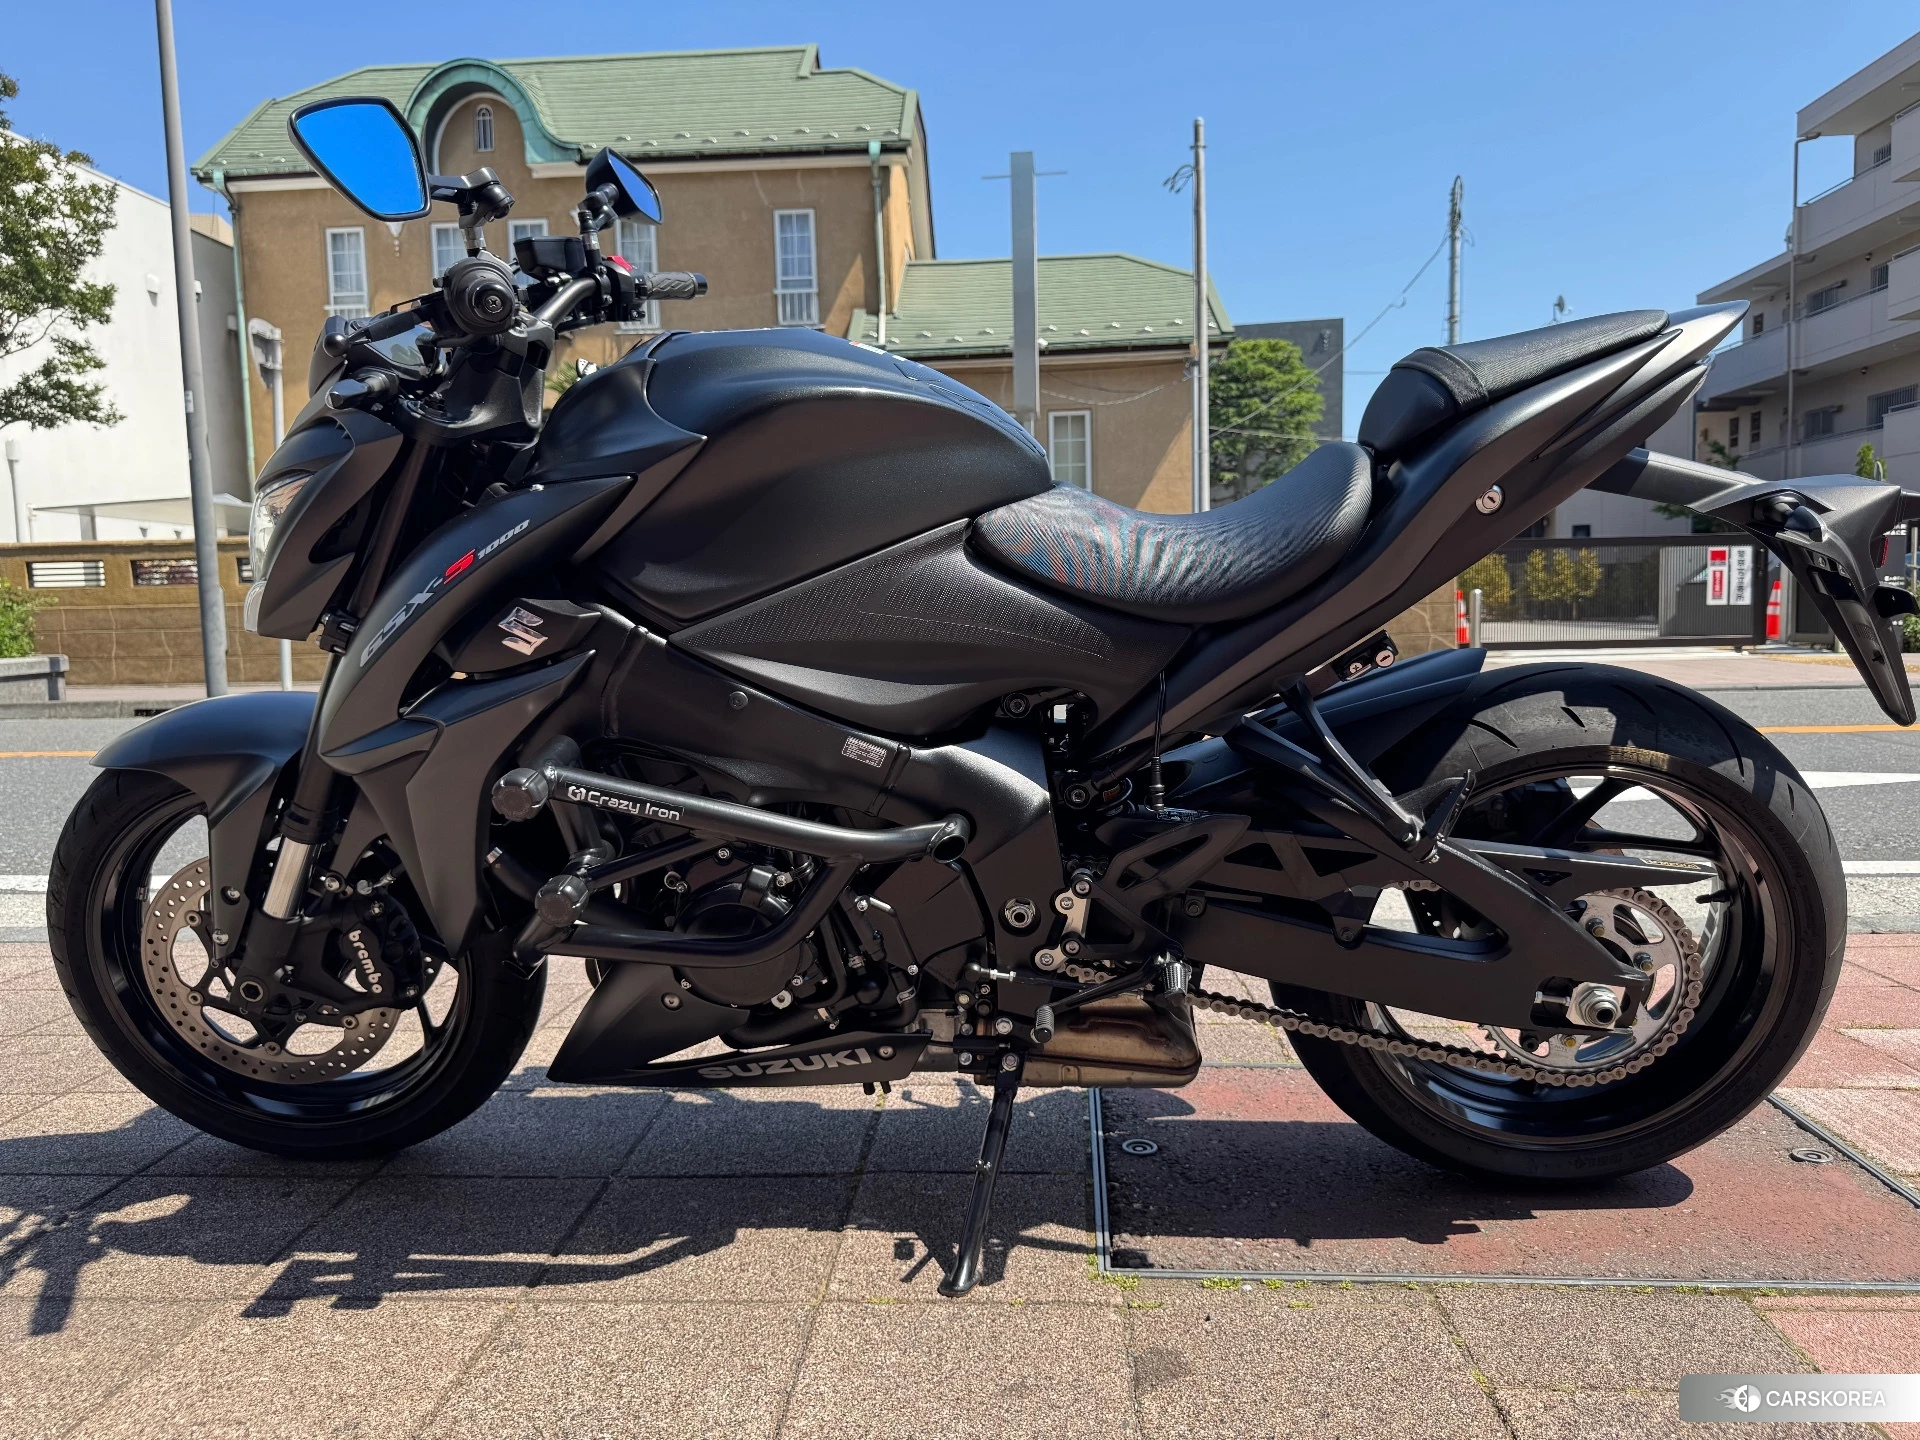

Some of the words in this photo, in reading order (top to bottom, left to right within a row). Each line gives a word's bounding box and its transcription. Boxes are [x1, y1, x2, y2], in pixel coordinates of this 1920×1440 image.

[587, 791, 641, 814] Crazy
[645, 802, 680, 821] Iron
[348, 929, 383, 994] brembo
[697, 1047, 872, 1079] SUZUKI
